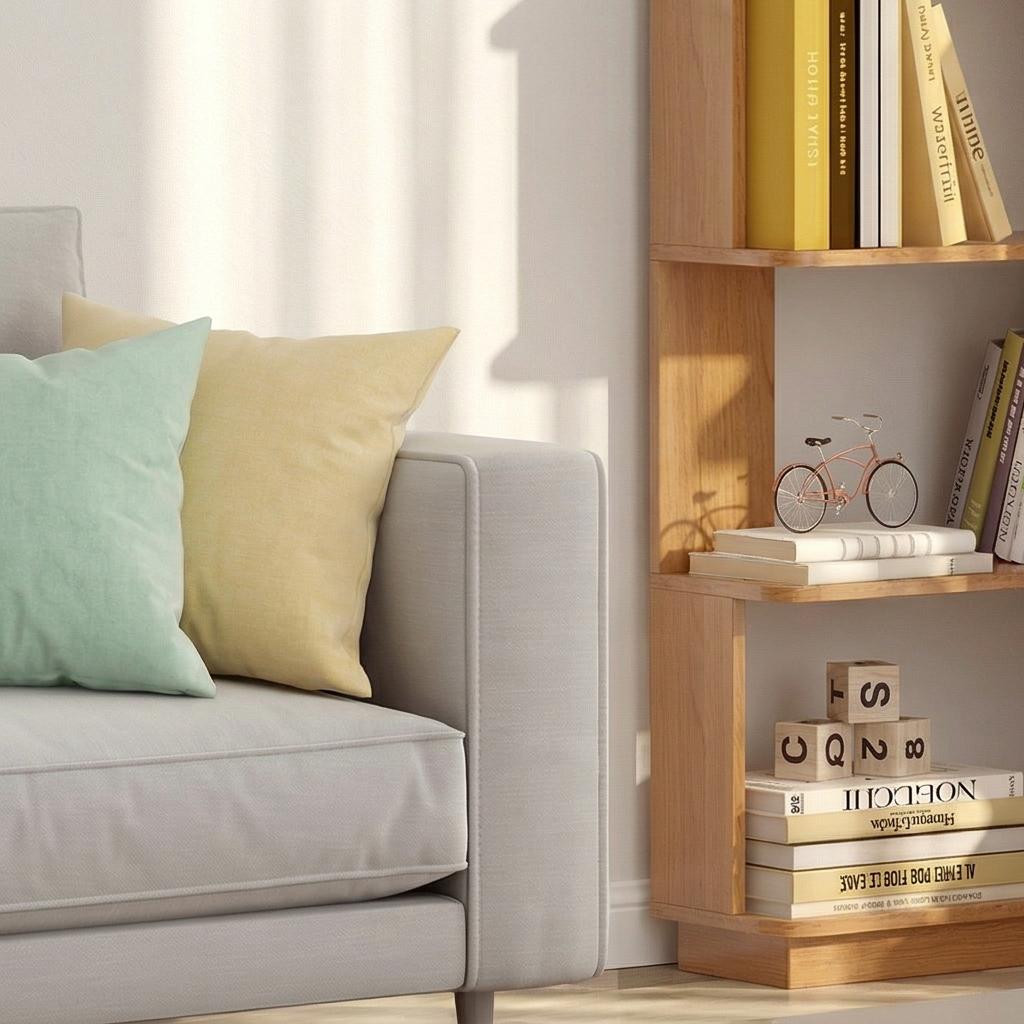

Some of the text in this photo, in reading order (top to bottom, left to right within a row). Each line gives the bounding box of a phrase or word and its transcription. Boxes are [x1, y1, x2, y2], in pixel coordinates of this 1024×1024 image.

[830, 679, 844, 704] T
[860, 681, 891, 708] S
[781, 736, 807, 764] C
[825, 733, 845, 767] Q
[861, 737, 888, 761] 2
[905, 737, 925, 760] 8
